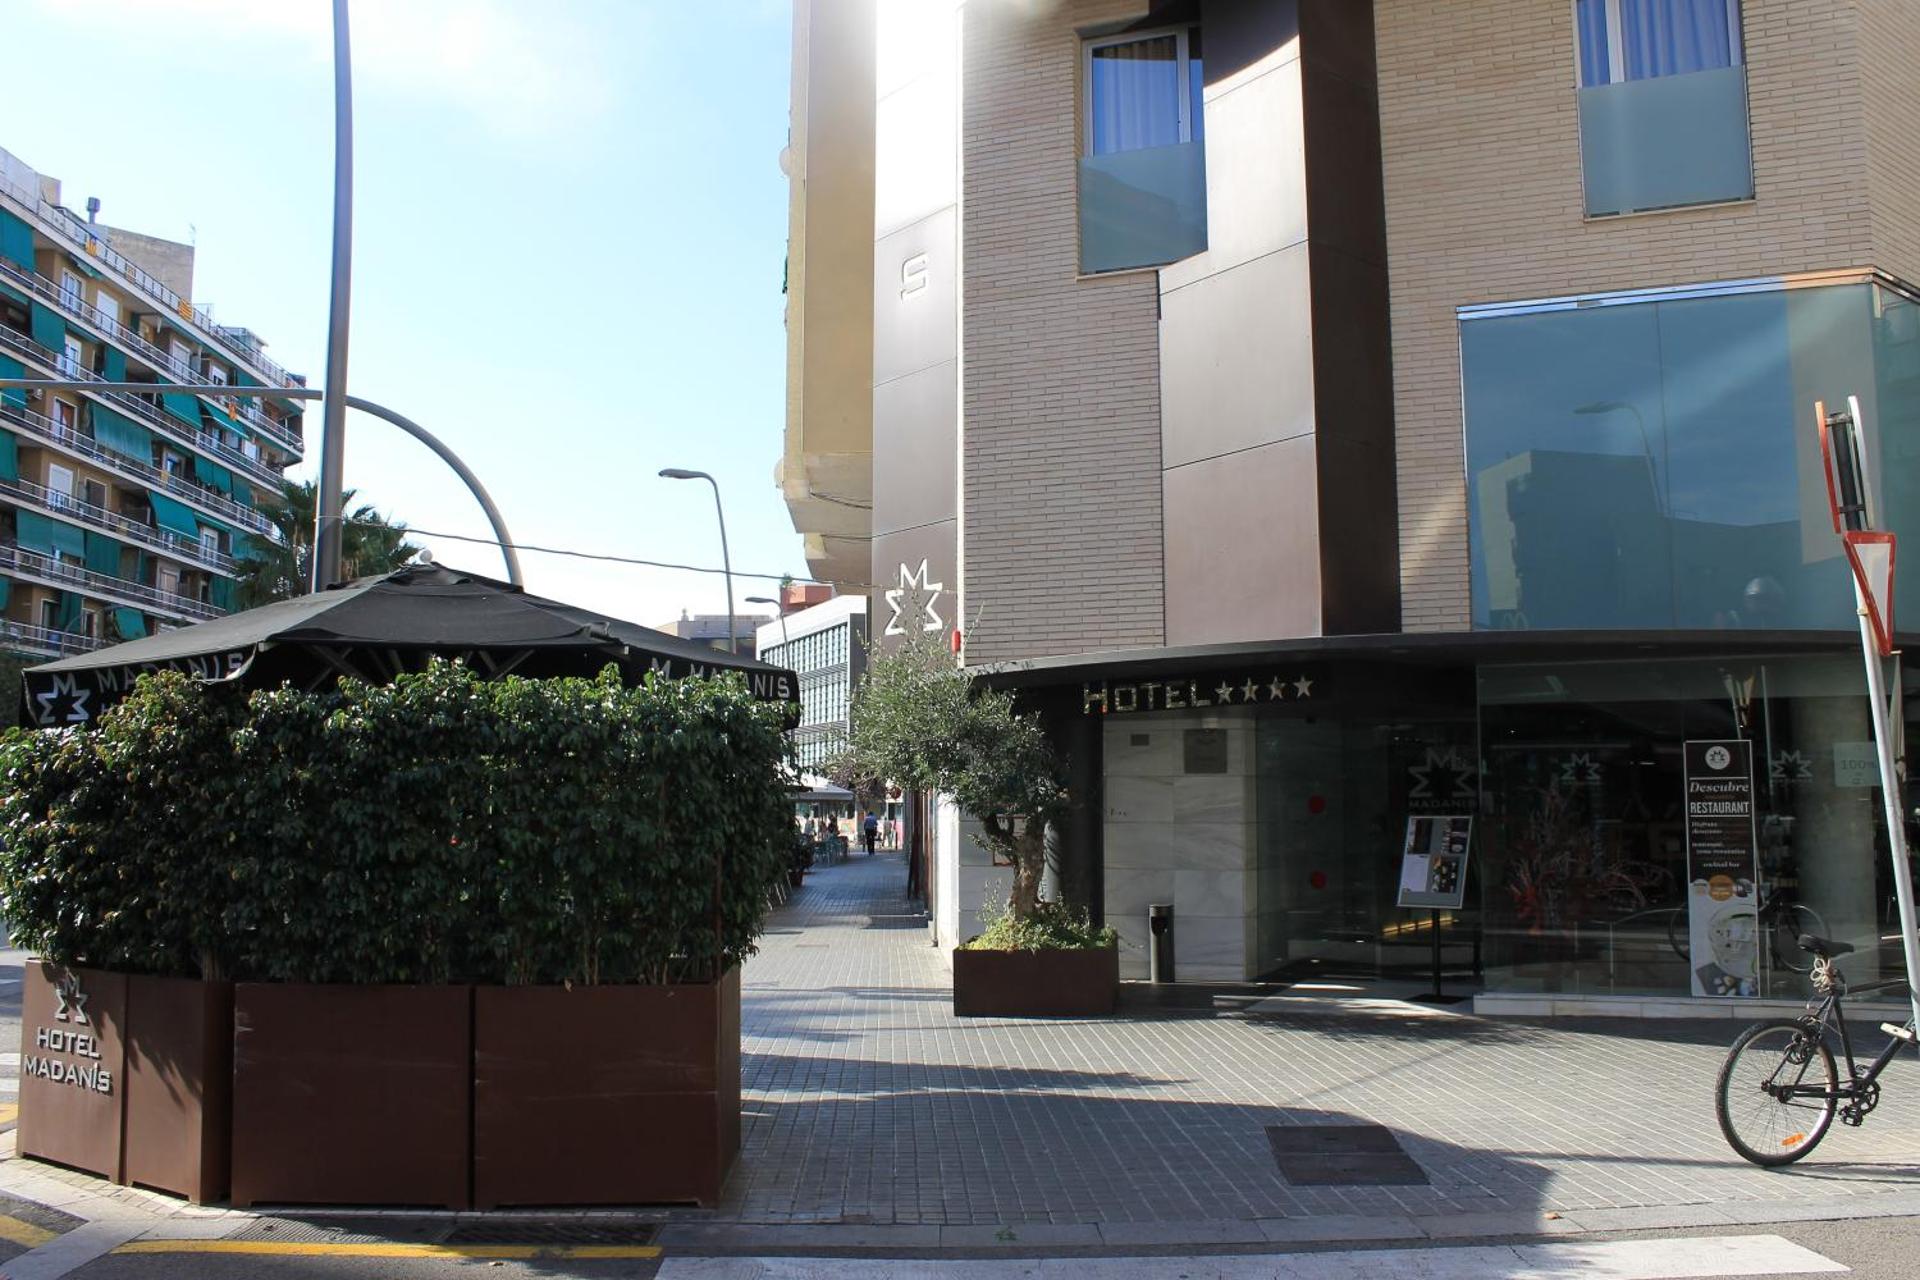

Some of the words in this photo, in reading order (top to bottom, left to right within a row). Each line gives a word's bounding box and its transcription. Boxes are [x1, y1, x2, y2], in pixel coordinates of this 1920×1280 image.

[1083, 679, 1211, 714] HOTEL
[1690, 781, 1749, 793] Descubre
[1690, 801, 1749, 814] RESTAURANT
[36, 1026, 101, 1058] HOTEL
